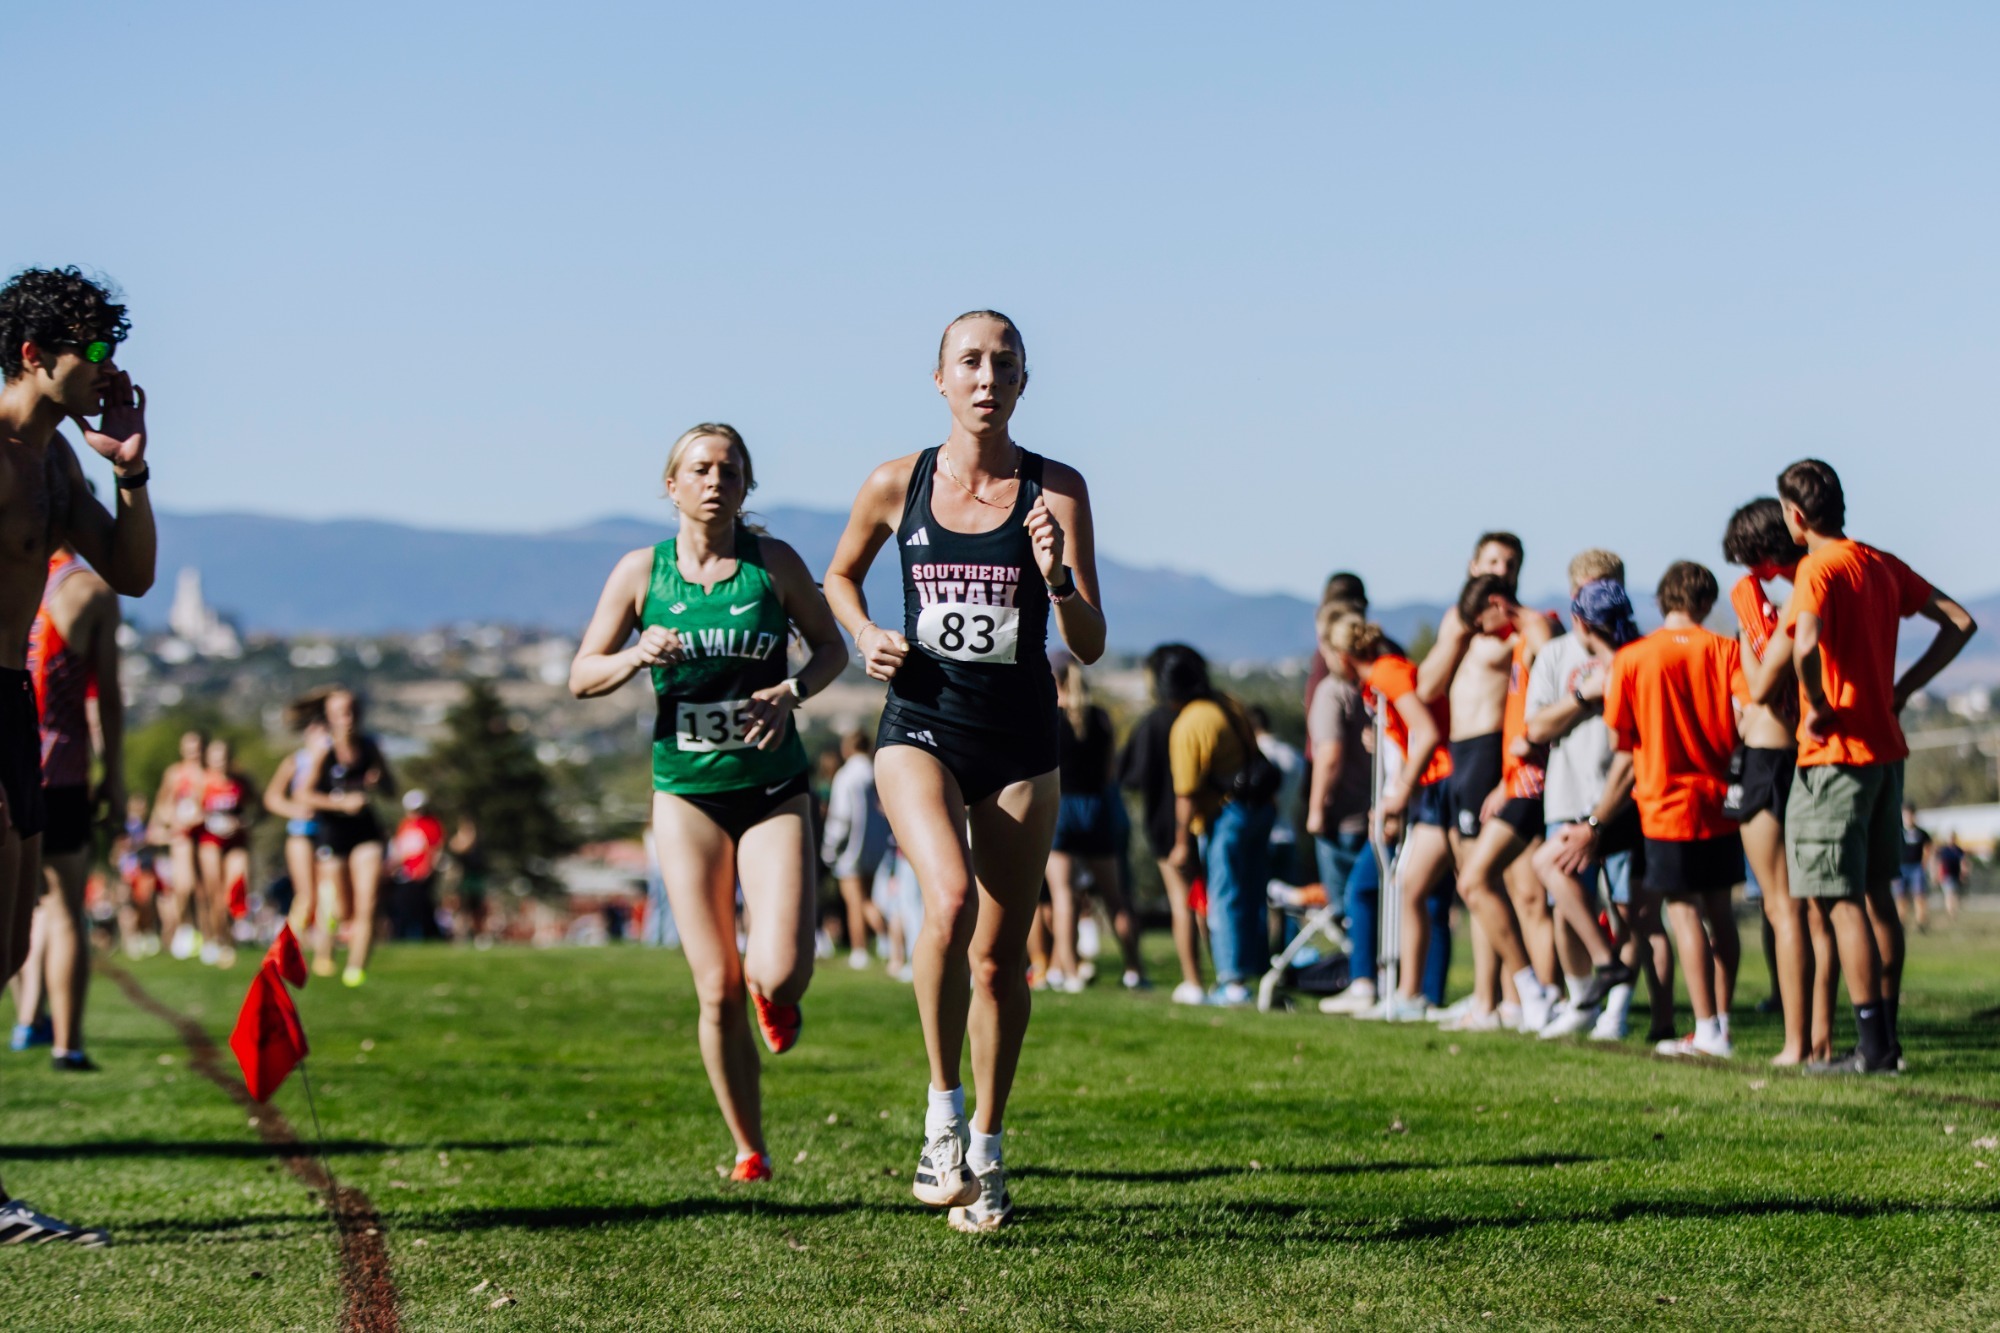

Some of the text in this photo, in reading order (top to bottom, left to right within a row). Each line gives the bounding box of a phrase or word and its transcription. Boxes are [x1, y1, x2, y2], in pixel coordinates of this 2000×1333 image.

[911, 563, 1021, 583] SOUTHERN
[914, 580, 1018, 608] UTAH
[697, 628, 778, 660] VALLEY
[939, 612, 995, 654] 83
